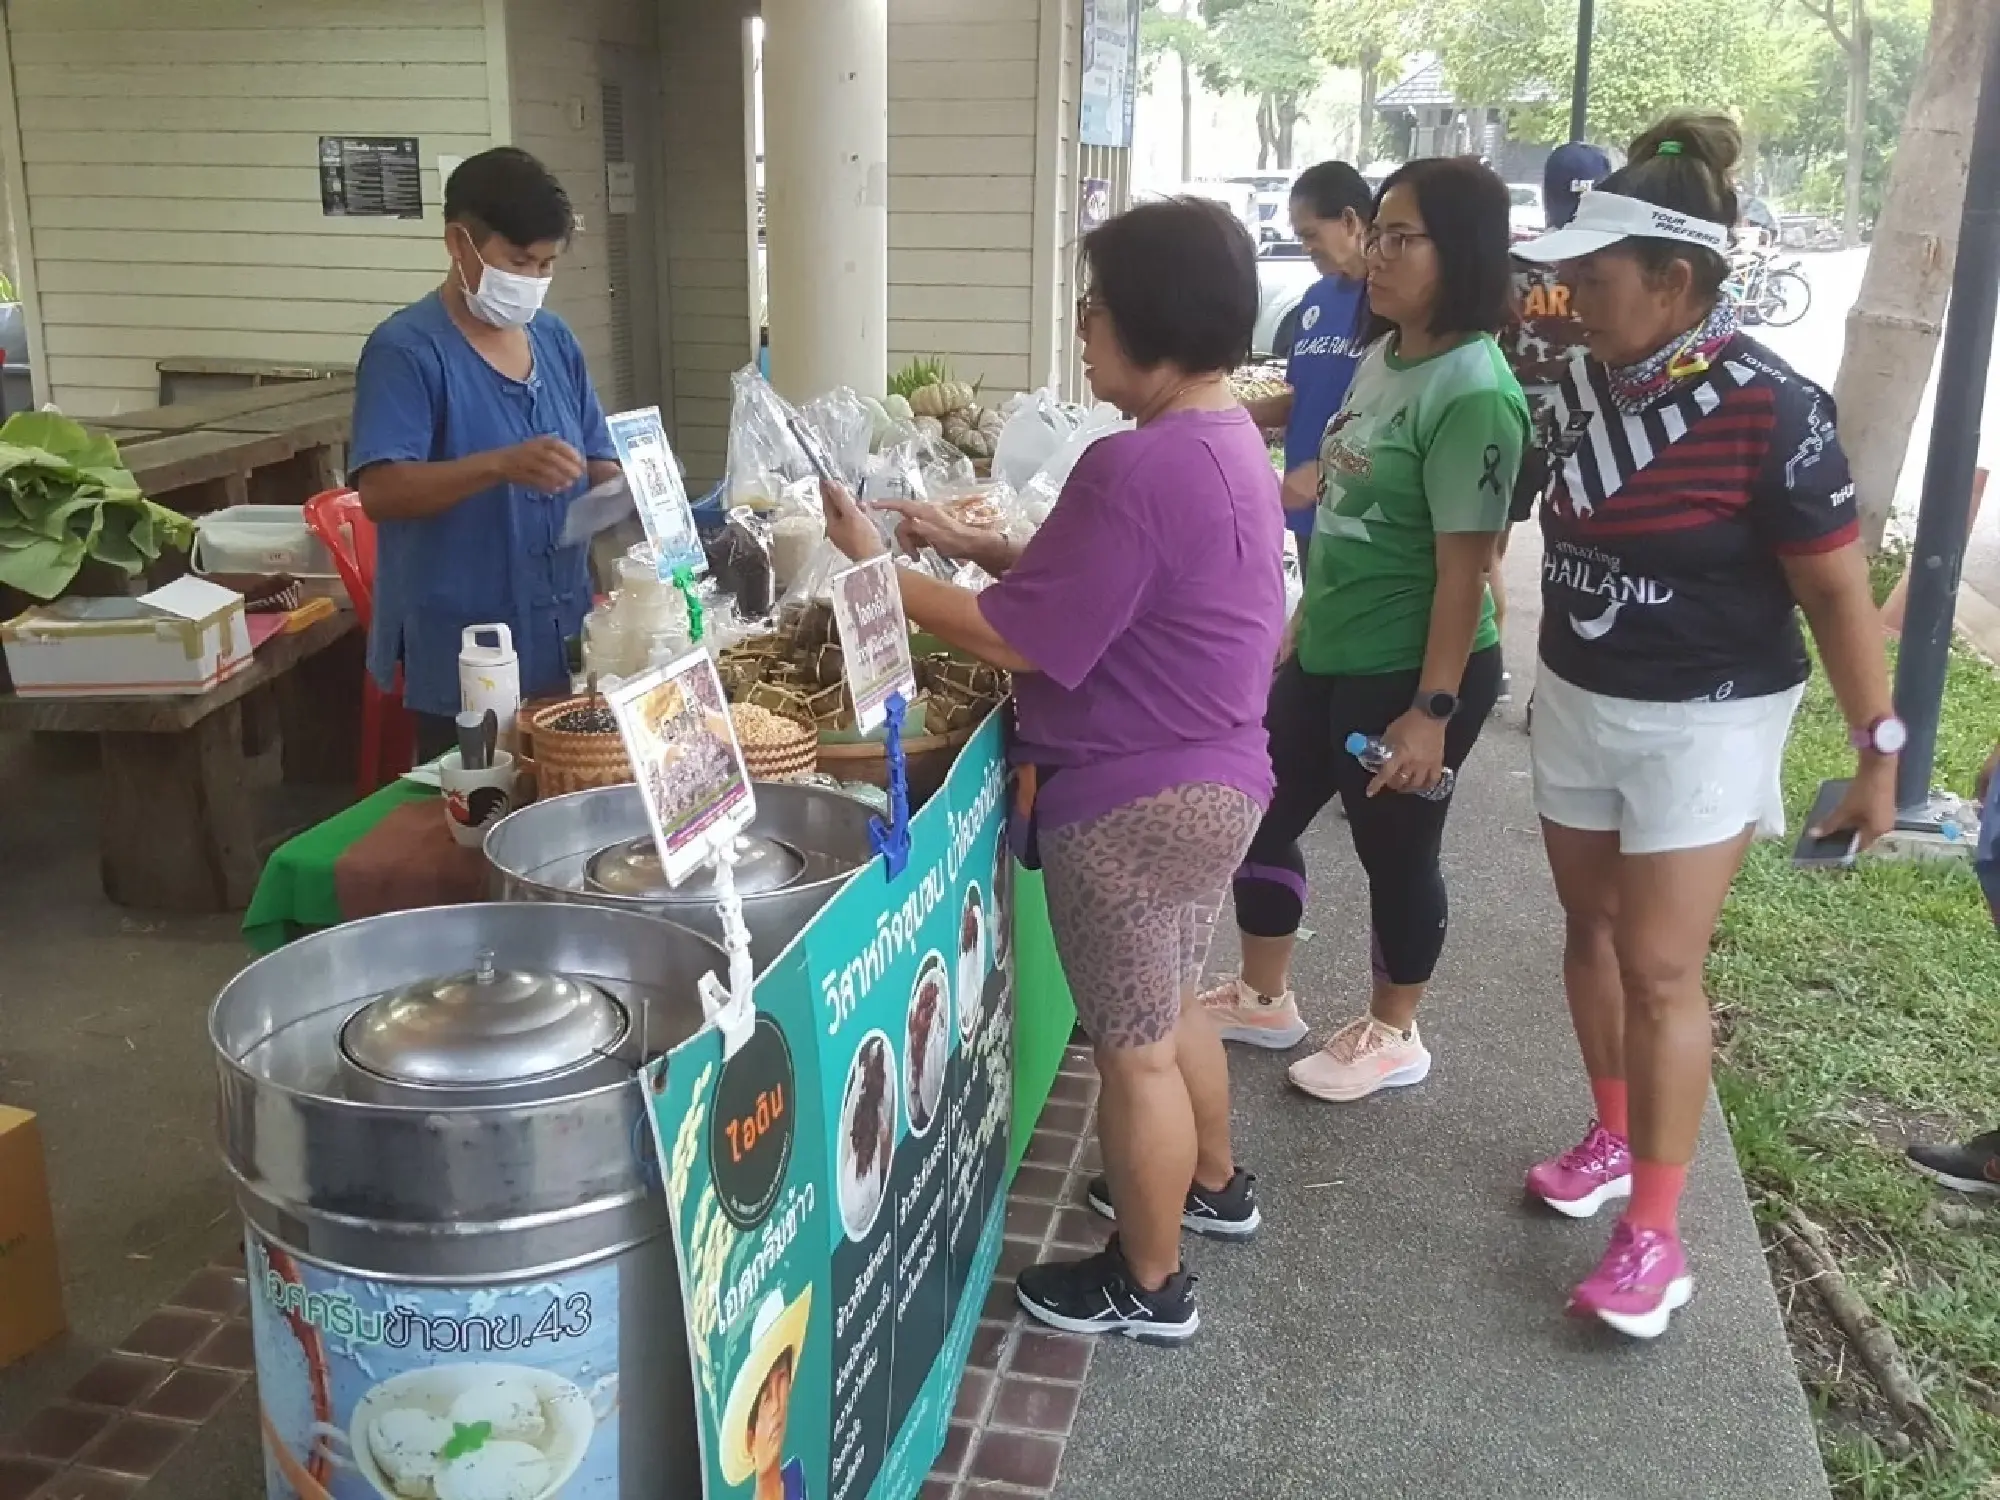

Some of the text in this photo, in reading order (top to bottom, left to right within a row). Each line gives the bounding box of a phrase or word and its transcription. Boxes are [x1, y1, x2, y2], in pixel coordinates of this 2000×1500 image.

[1652, 211, 1687, 225] TOUR
[1741, 352, 1788, 383] TOYOTA
[1555, 541, 1620, 573] amazing
[1543, 552, 1674, 604] HAILAND
[725, 1083, 784, 1162] ไอดิน
